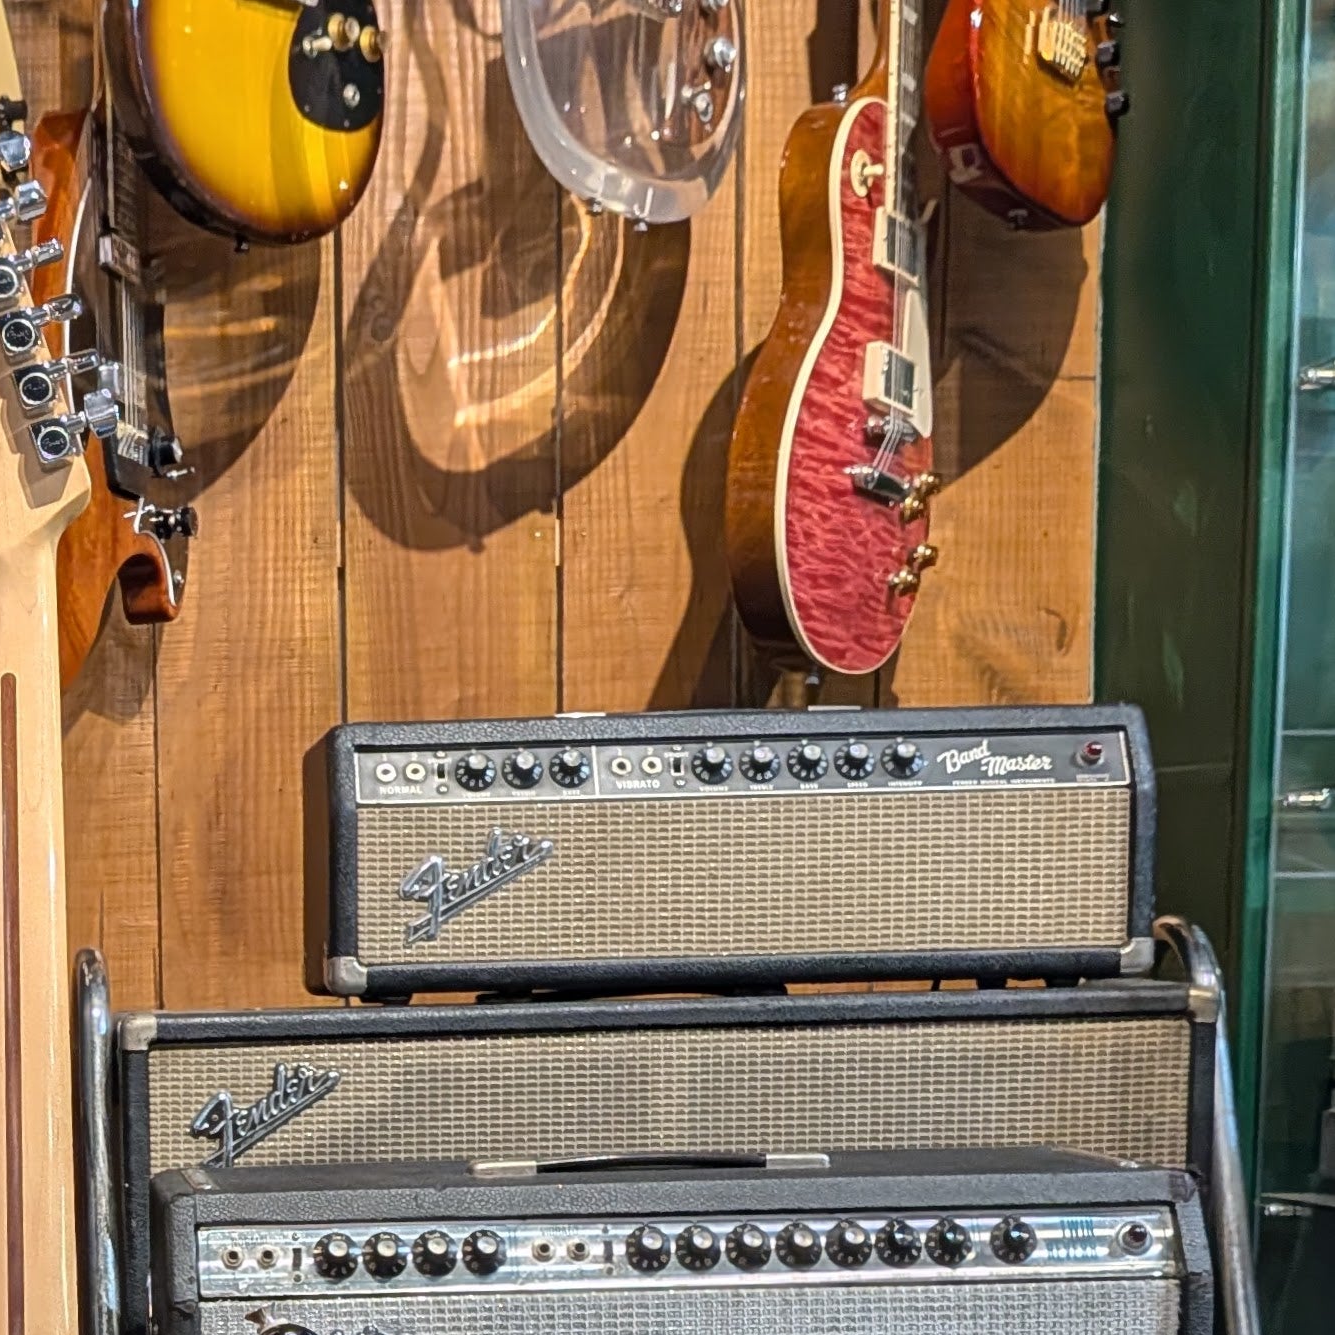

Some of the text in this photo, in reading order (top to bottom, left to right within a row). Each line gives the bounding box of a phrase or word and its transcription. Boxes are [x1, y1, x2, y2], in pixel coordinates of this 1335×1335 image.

[937, 739, 991, 774] Band
[379, 785, 423, 794] NORMAL
[616, 780, 660, 789] VIBRATO
[400, 826, 554, 946] Fender
[191, 1062, 342, 1168] Fender
